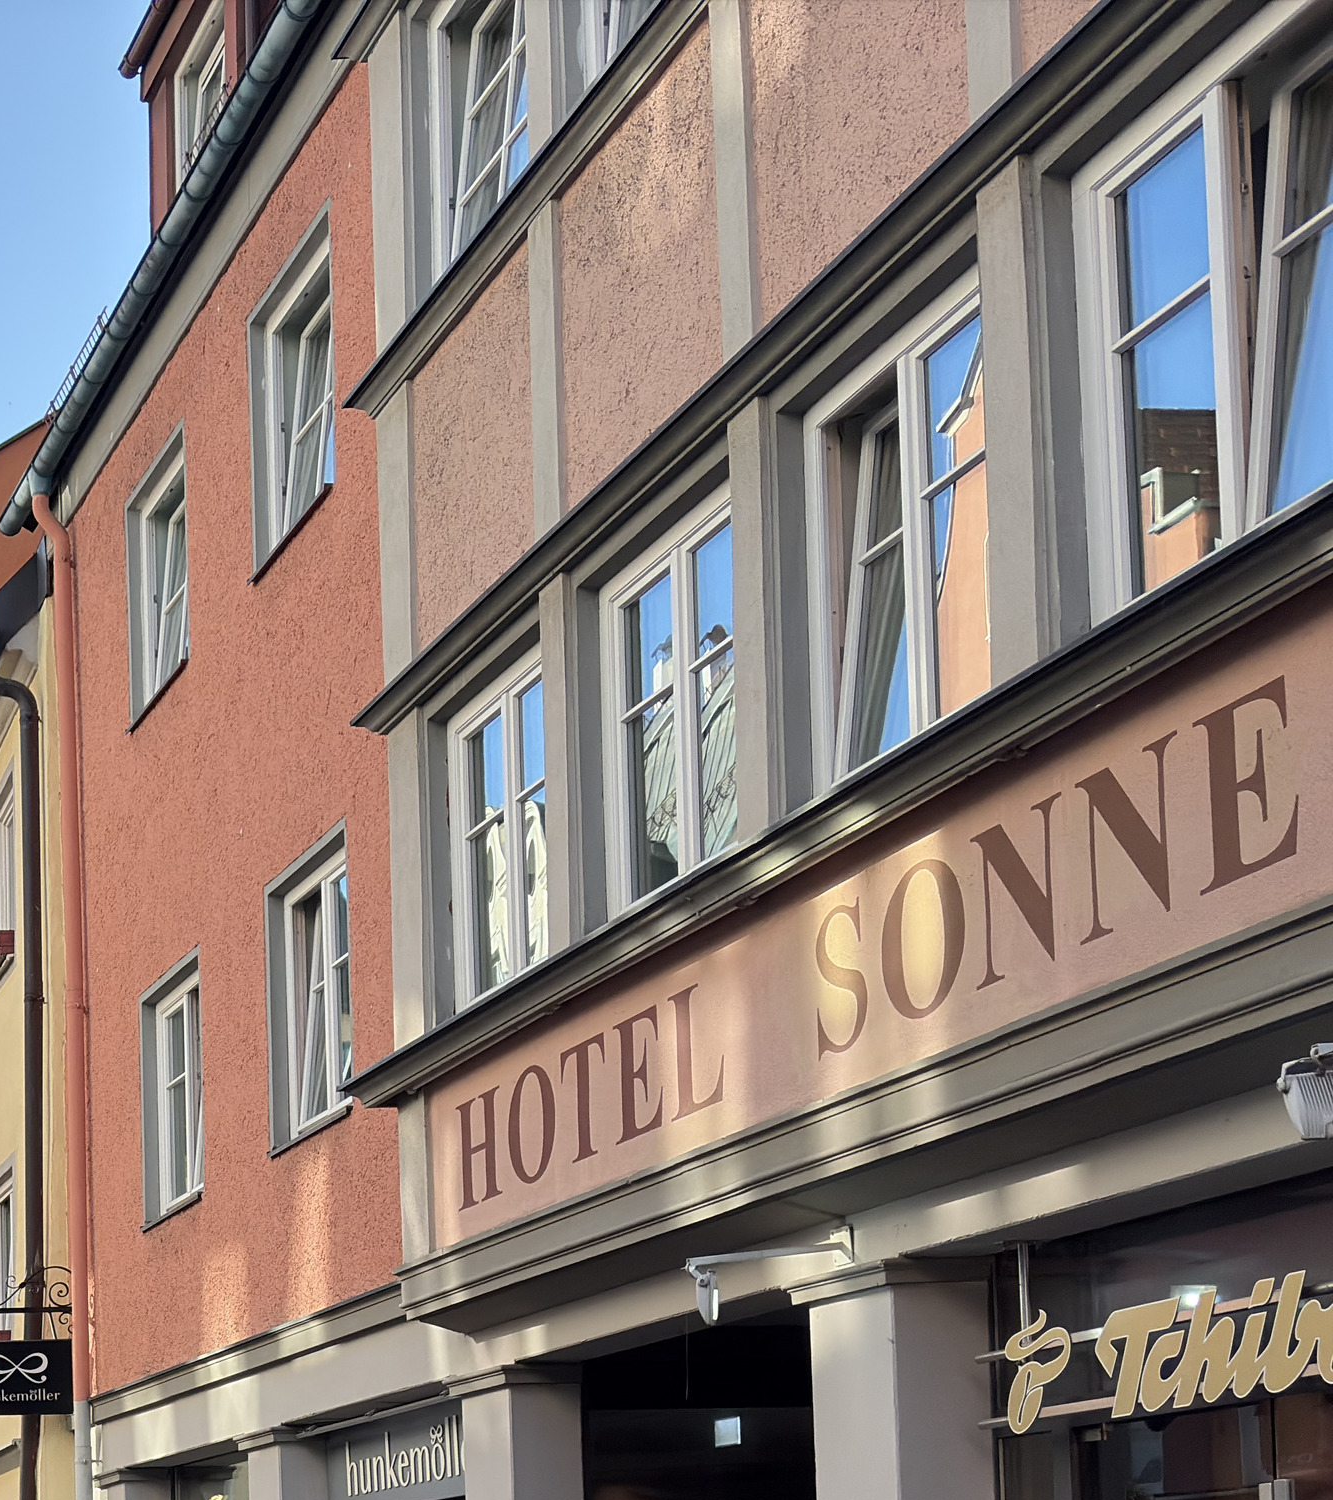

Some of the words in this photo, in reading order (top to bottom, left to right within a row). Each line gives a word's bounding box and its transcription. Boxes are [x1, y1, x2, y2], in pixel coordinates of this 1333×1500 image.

[456, 983, 725, 1212] HOTEL
[816, 674, 1300, 1062] SONNE
[345, 1414, 466, 1497] hunkemöll
